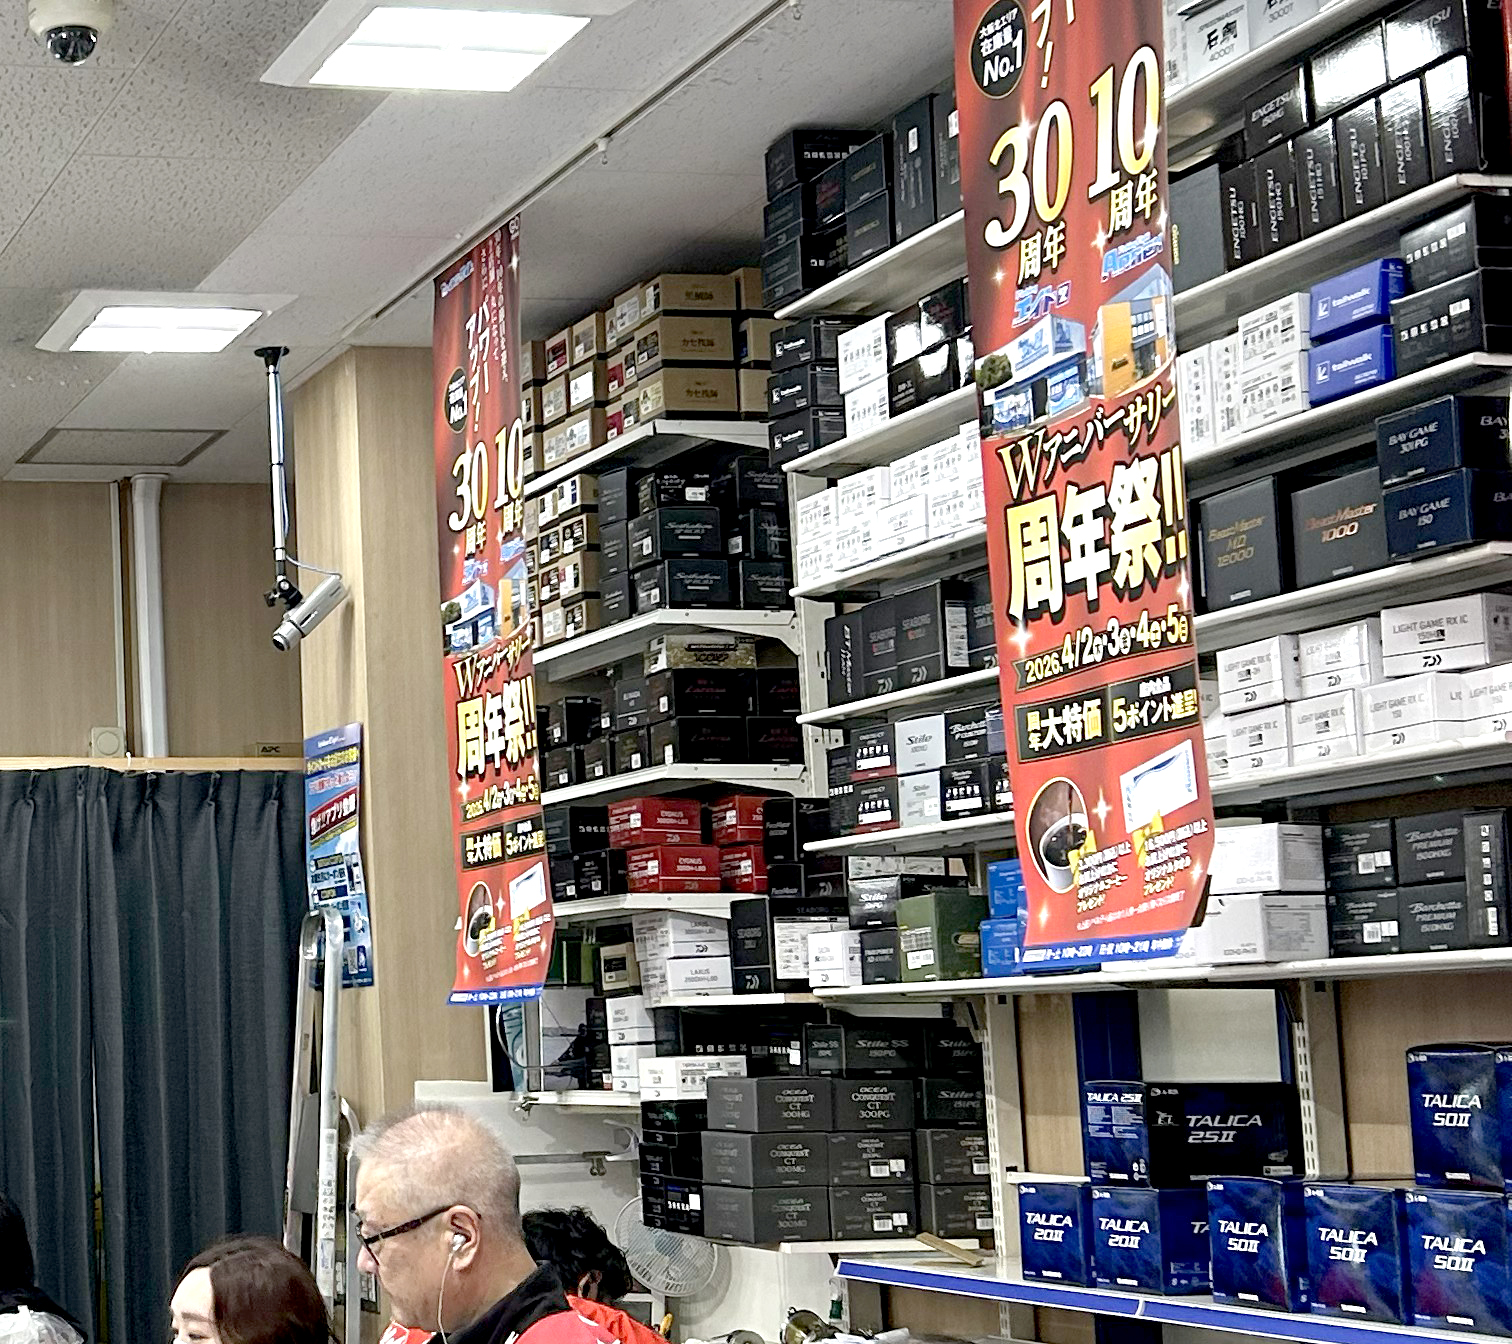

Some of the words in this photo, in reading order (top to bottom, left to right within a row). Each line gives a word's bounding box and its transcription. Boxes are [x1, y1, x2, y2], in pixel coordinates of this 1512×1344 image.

[982, 29, 1024, 87] No.1
[1251, 89, 1293, 123] ENGETSU
[1089, 45, 1161, 200] 10
[984, 99, 1073, 250] 30
[1348, 128, 1364, 205] ENGETSU
[1306, 148, 1321, 223] ENGETSU
[1107, 172, 1160, 241] 周年
[1266, 168, 1280, 243] ENGETSU
[1228, 186, 1242, 260] ENGETSU
[1017, 220, 1067, 286] 周年
[1388, 430, 1416, 447] BAY
[1416, 421, 1439, 444] GAME
[493, 417, 524, 509] 10
[448, 441, 489, 533] 30
[1398, 505, 1421, 522] BAY
[1420, 497, 1451, 516] GAME
[1321, 522, 1359, 543] 1000
[1392, 622, 1418, 634] LIGHT
[1418, 618, 1445, 630] GAME
[866, 1101, 881, 1110] CT
[1087, 1093, 1119, 1103] TALICA
[1421, 1092, 1482, 1110] TALICA
[1186, 1114, 1263, 1128] TALICA
[1025, 1211, 1073, 1229] TALICA
[1098, 1217, 1150, 1234] TALICA
[1217, 1219, 1269, 1238] TALICA
[1317, 1226, 1379, 1247] TALICA
[1420, 1234, 1487, 1255] TALICA
